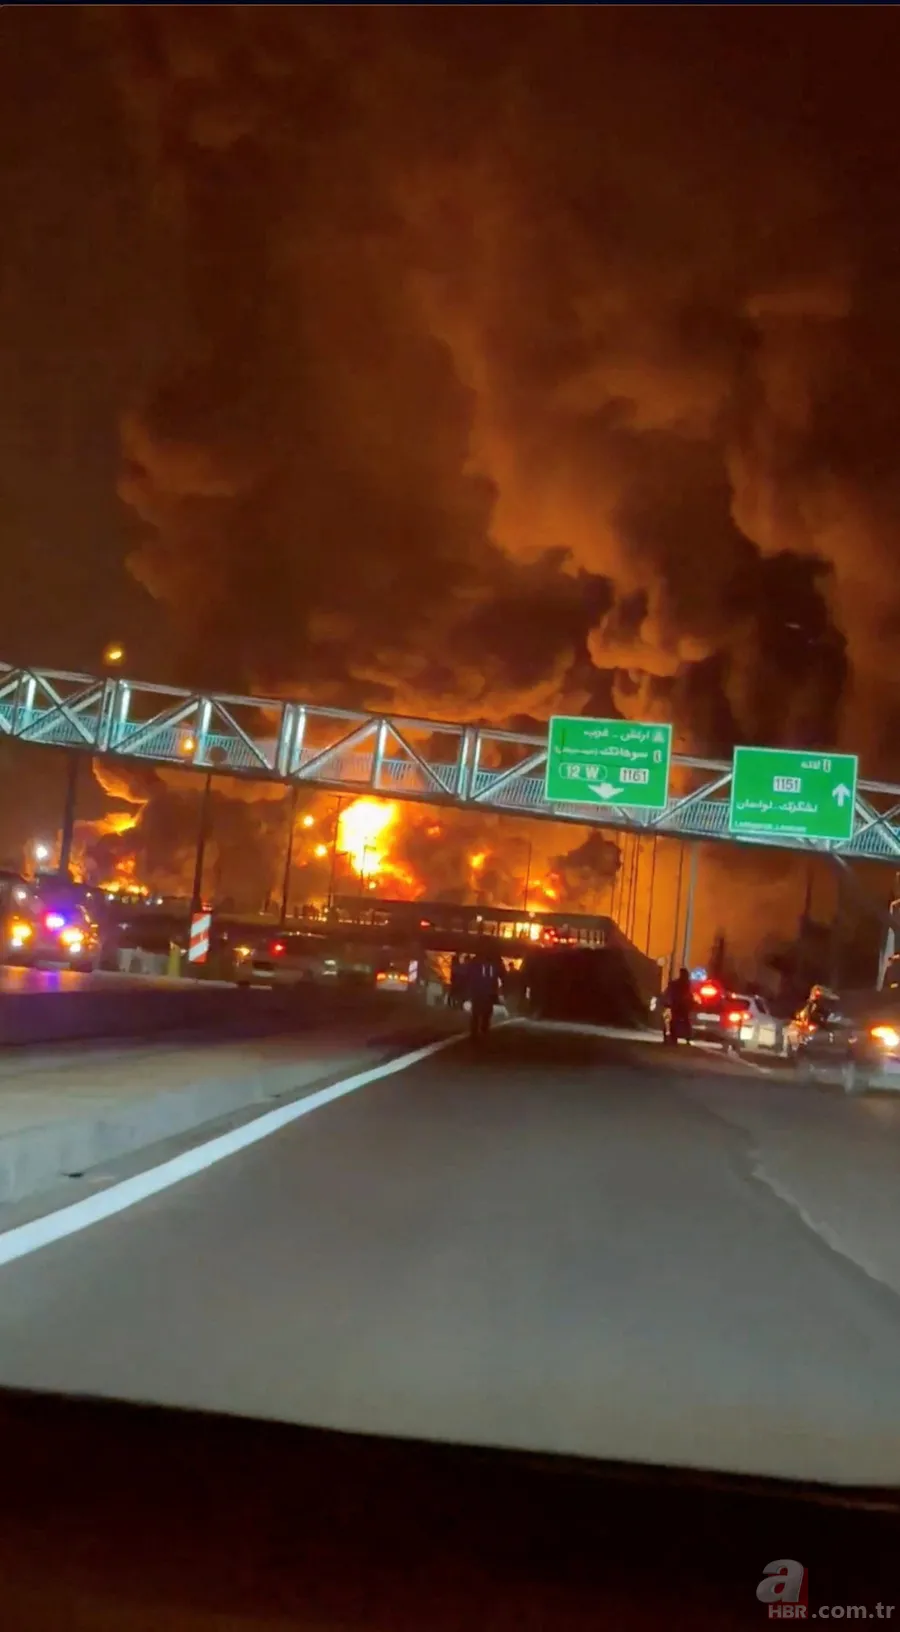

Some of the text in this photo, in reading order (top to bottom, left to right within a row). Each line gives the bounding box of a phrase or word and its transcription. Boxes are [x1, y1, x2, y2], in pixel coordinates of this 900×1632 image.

[566, 764, 600, 779] 12 W
[622, 769, 647, 782] 1161
[776, 778, 799, 792] 1151
